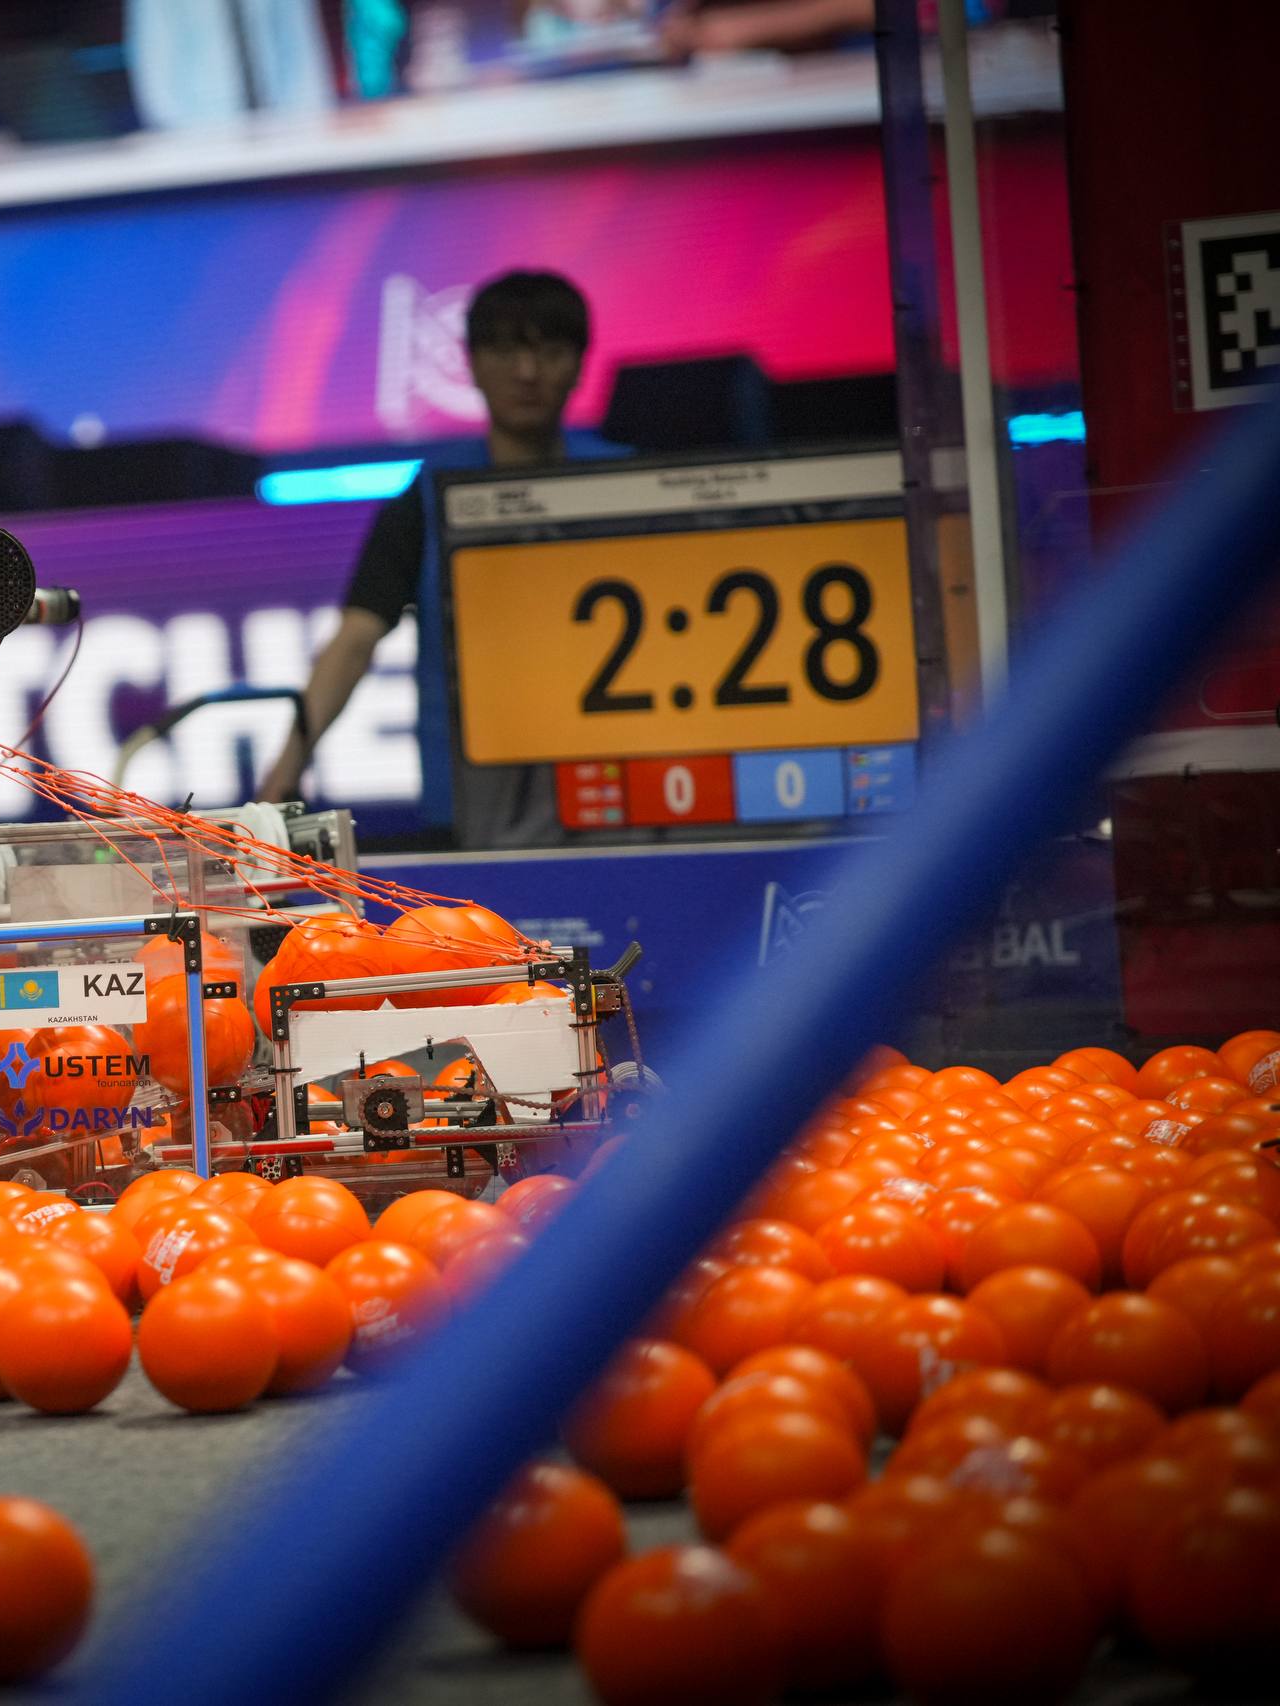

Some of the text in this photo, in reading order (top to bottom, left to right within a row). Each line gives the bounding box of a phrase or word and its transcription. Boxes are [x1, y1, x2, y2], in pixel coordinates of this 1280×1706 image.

[571, 561, 880, 716] 2:28
[663, 760, 805, 815] 0 0
[83, 972, 145, 997] KAZ
[47, 1015, 98, 1024] KAZAKHSTAN
[45, 1055, 151, 1078] USTEM
[97, 1078, 151, 1088] foundation
[49, 1106, 153, 1131] DARYN
